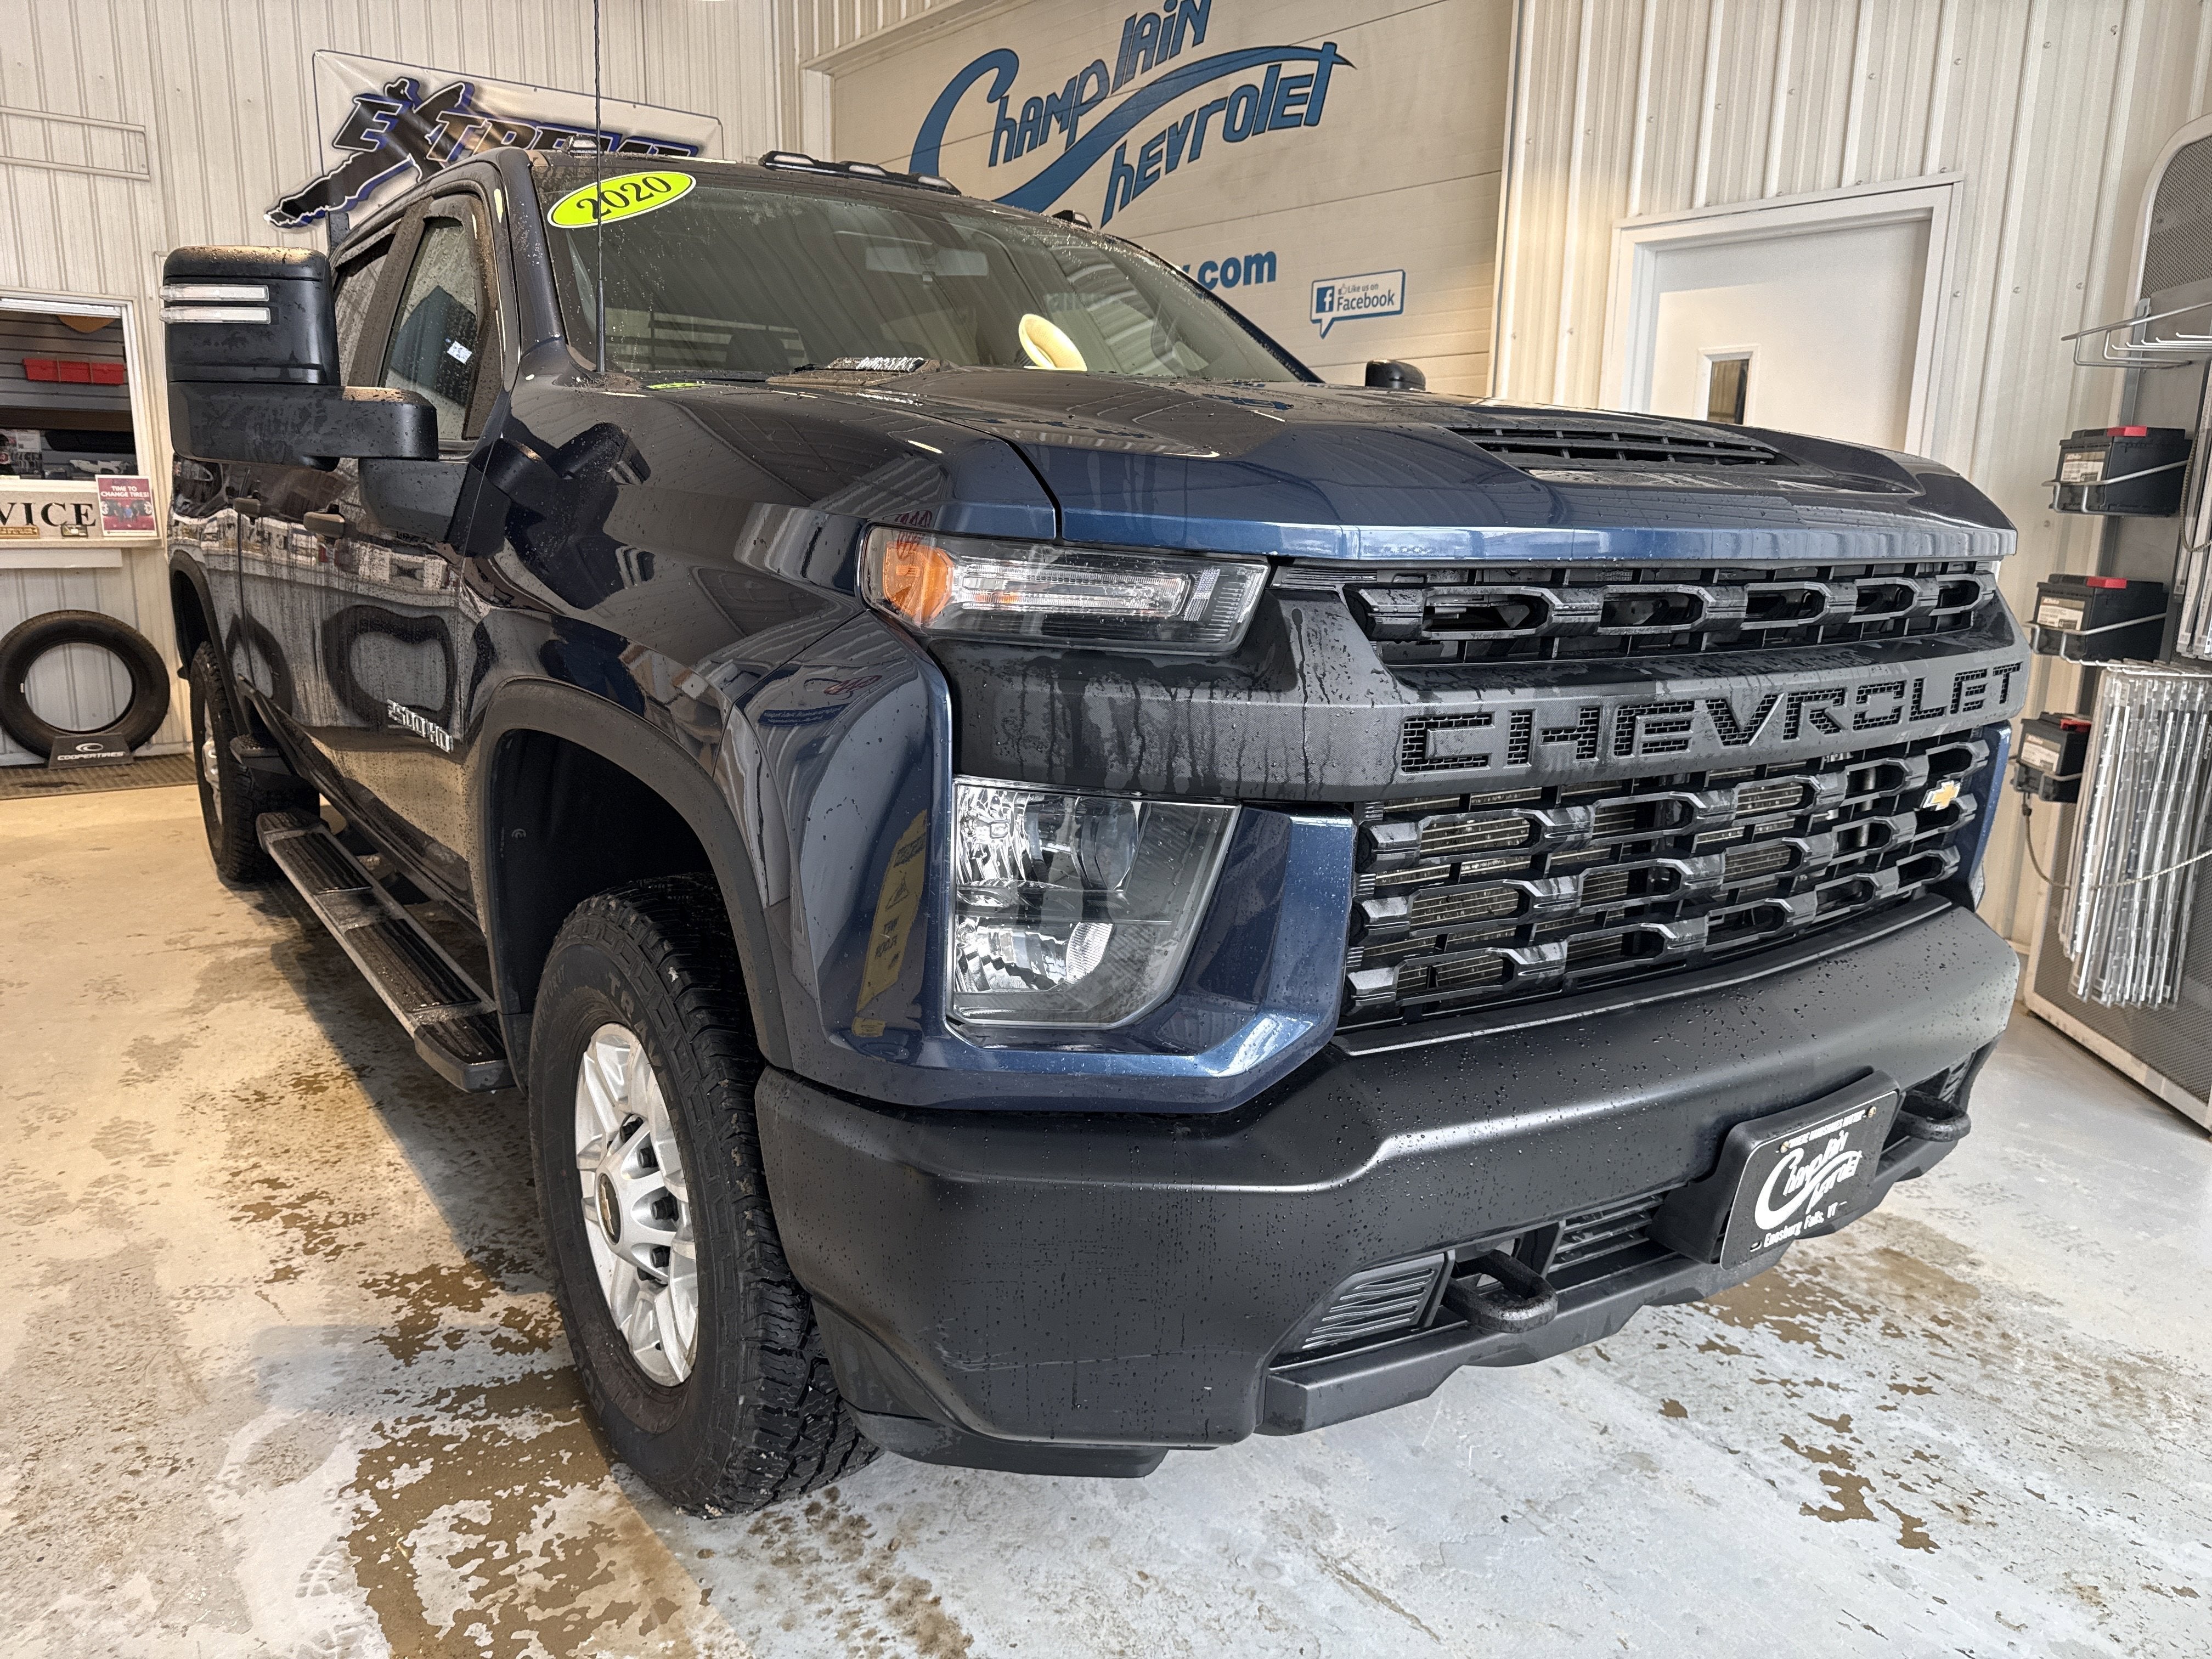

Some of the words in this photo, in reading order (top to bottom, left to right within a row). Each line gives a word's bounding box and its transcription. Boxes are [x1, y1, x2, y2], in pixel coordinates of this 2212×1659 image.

[576, 176, 672, 220] 2020
[1337, 289, 1395, 312] Facebook
[1348, 284, 1360, 293] Like
[387, 699, 454, 754] 2500HD
[1401, 661, 2022, 775] CHEVROLET
